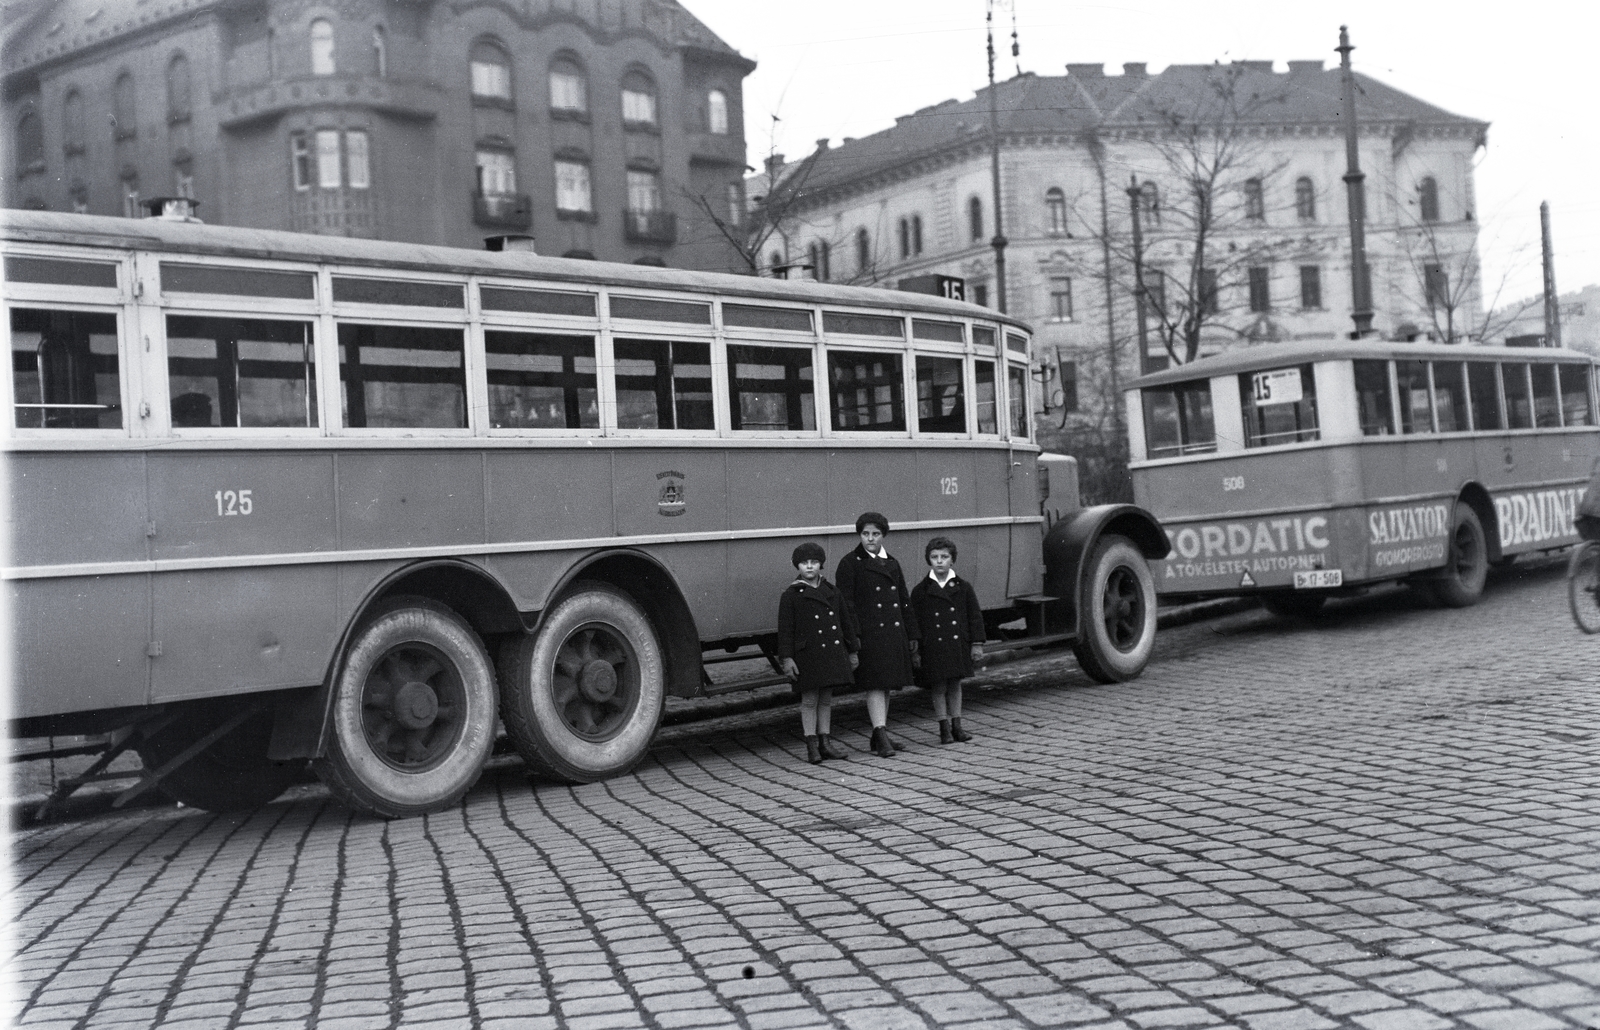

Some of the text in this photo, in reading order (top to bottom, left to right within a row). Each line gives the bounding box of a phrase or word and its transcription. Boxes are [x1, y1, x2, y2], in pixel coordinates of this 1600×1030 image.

[1254, 375, 1271, 400] 15
[940, 476, 959, 495] 125
[1222, 476, 1245, 491] 508
[214, 489, 253, 516] 125
[1370, 505, 1449, 545] SALVATOR
[1165, 564, 1176, 578] A
